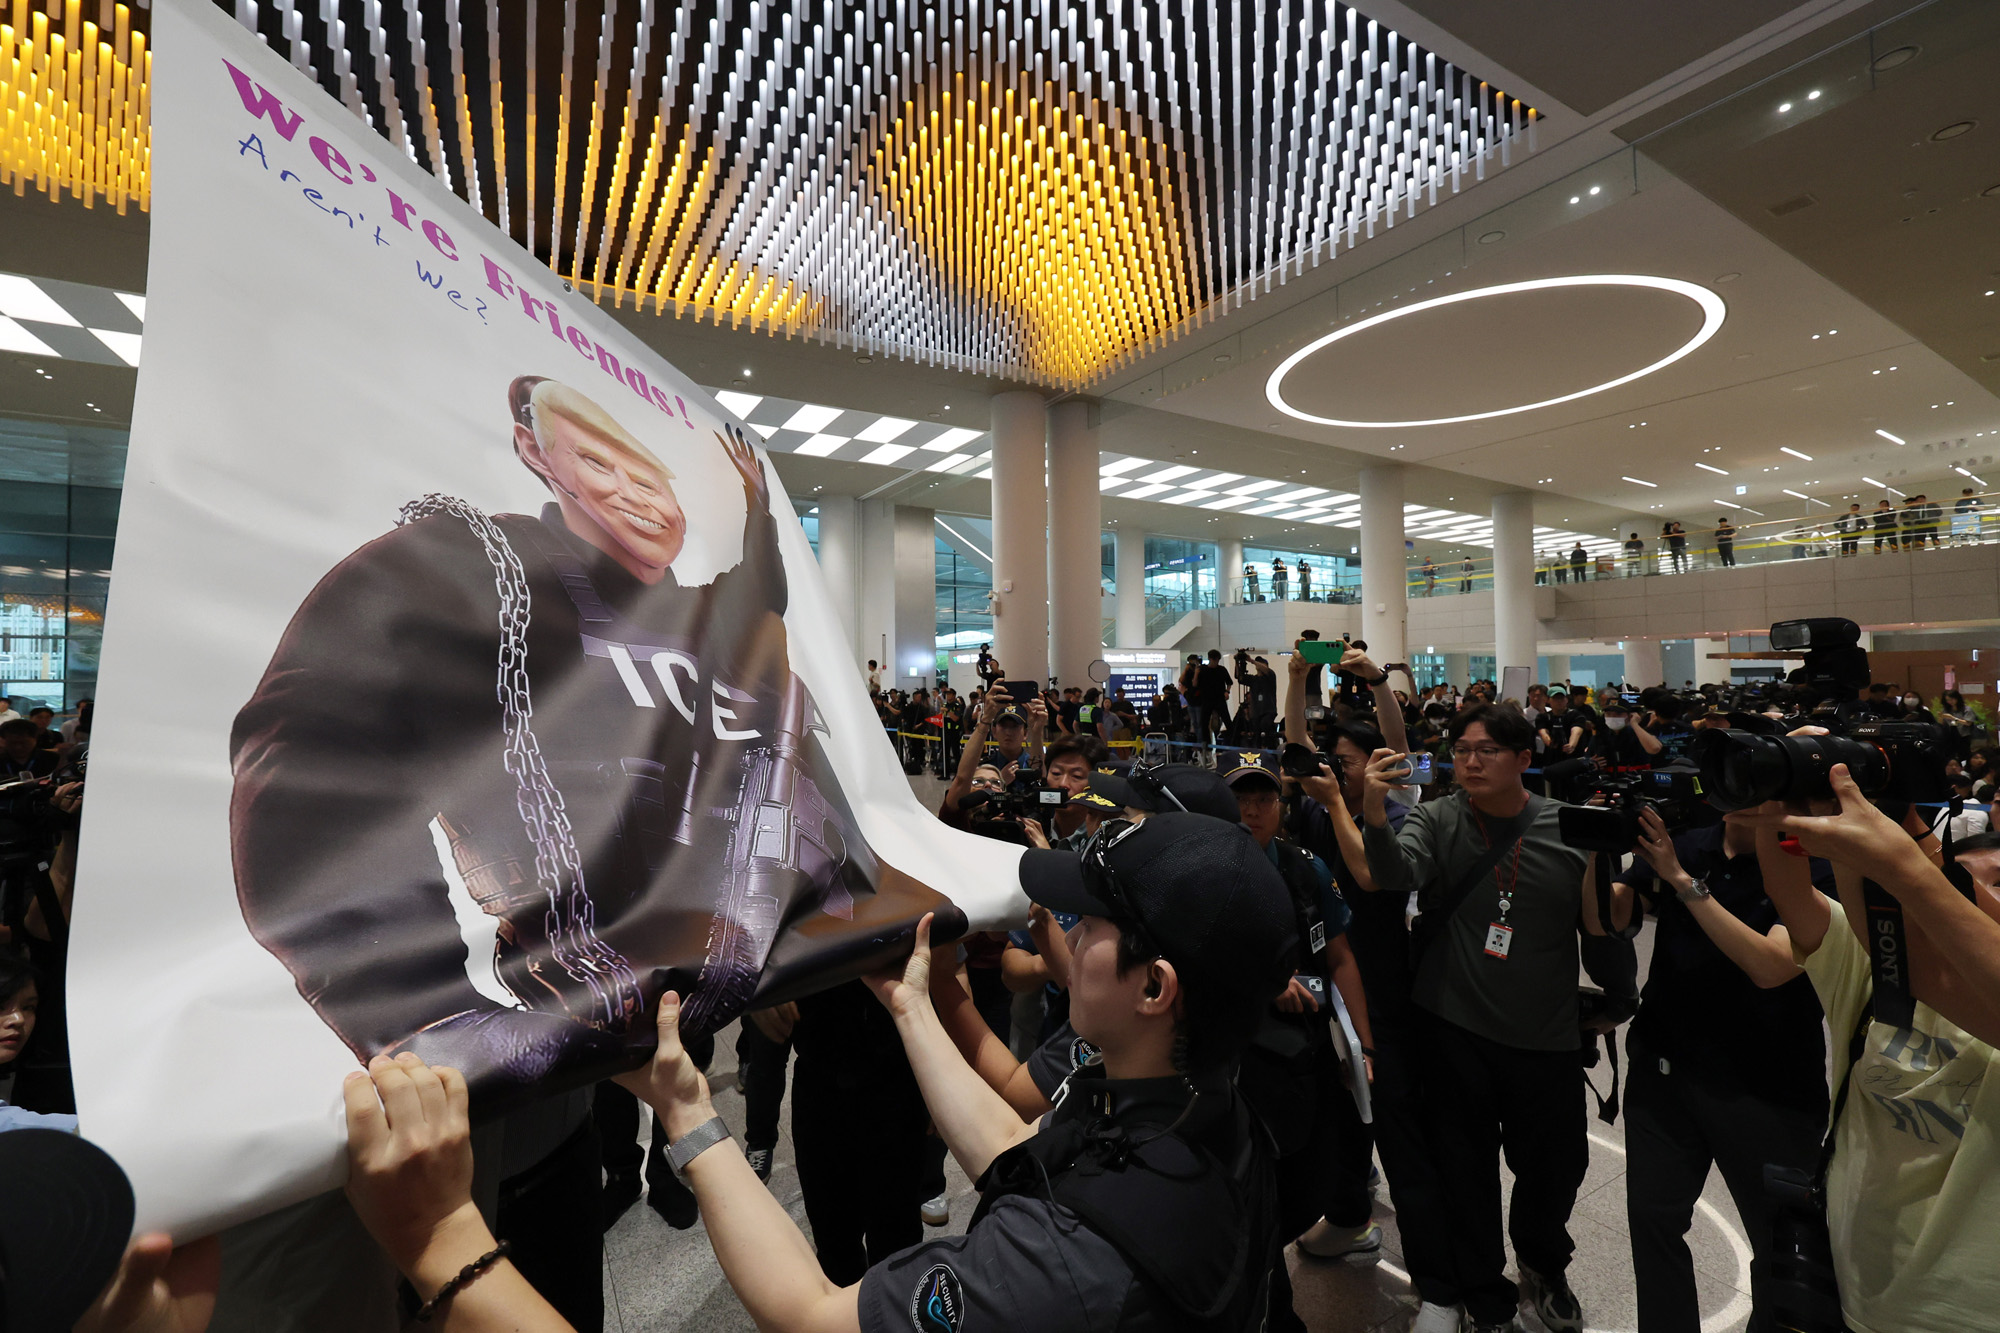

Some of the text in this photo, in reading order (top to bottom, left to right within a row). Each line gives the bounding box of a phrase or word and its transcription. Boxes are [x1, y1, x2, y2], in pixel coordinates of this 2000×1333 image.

[238, 133, 390, 246] Aren't
[222, 58, 695, 430] We're Friends!
[607, 645, 762, 741] ICE
[1877, 919, 1899, 988] SONY
[939, 1273, 957, 1324] SECURITY
